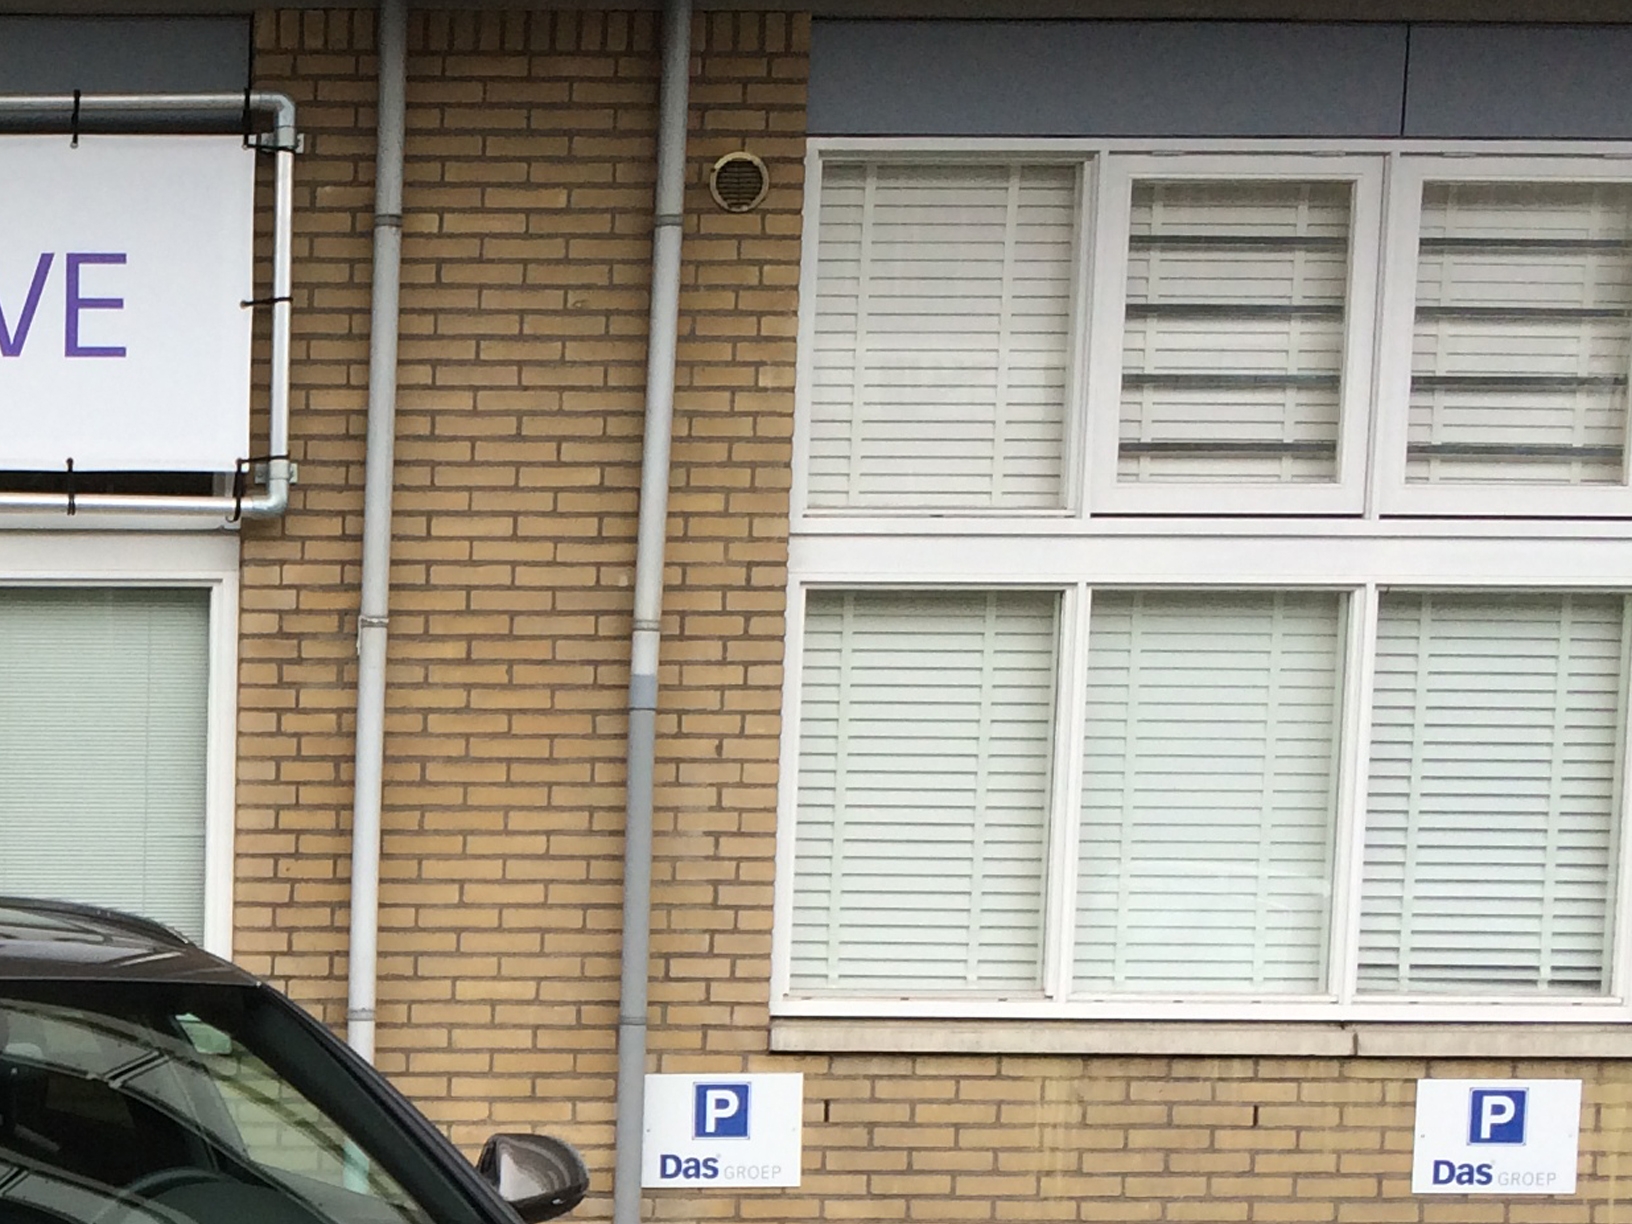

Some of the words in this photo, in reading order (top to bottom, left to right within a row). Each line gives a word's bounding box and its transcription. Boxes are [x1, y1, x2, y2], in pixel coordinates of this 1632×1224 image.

[705, 1089, 739, 1133] P
[1480, 1095, 1515, 1139] P
[659, 1154, 719, 1179] Das
[723, 1165, 782, 1180] GROEP
[1432, 1159, 1493, 1186] Das
[1497, 1171, 1557, 1187] GROEP
